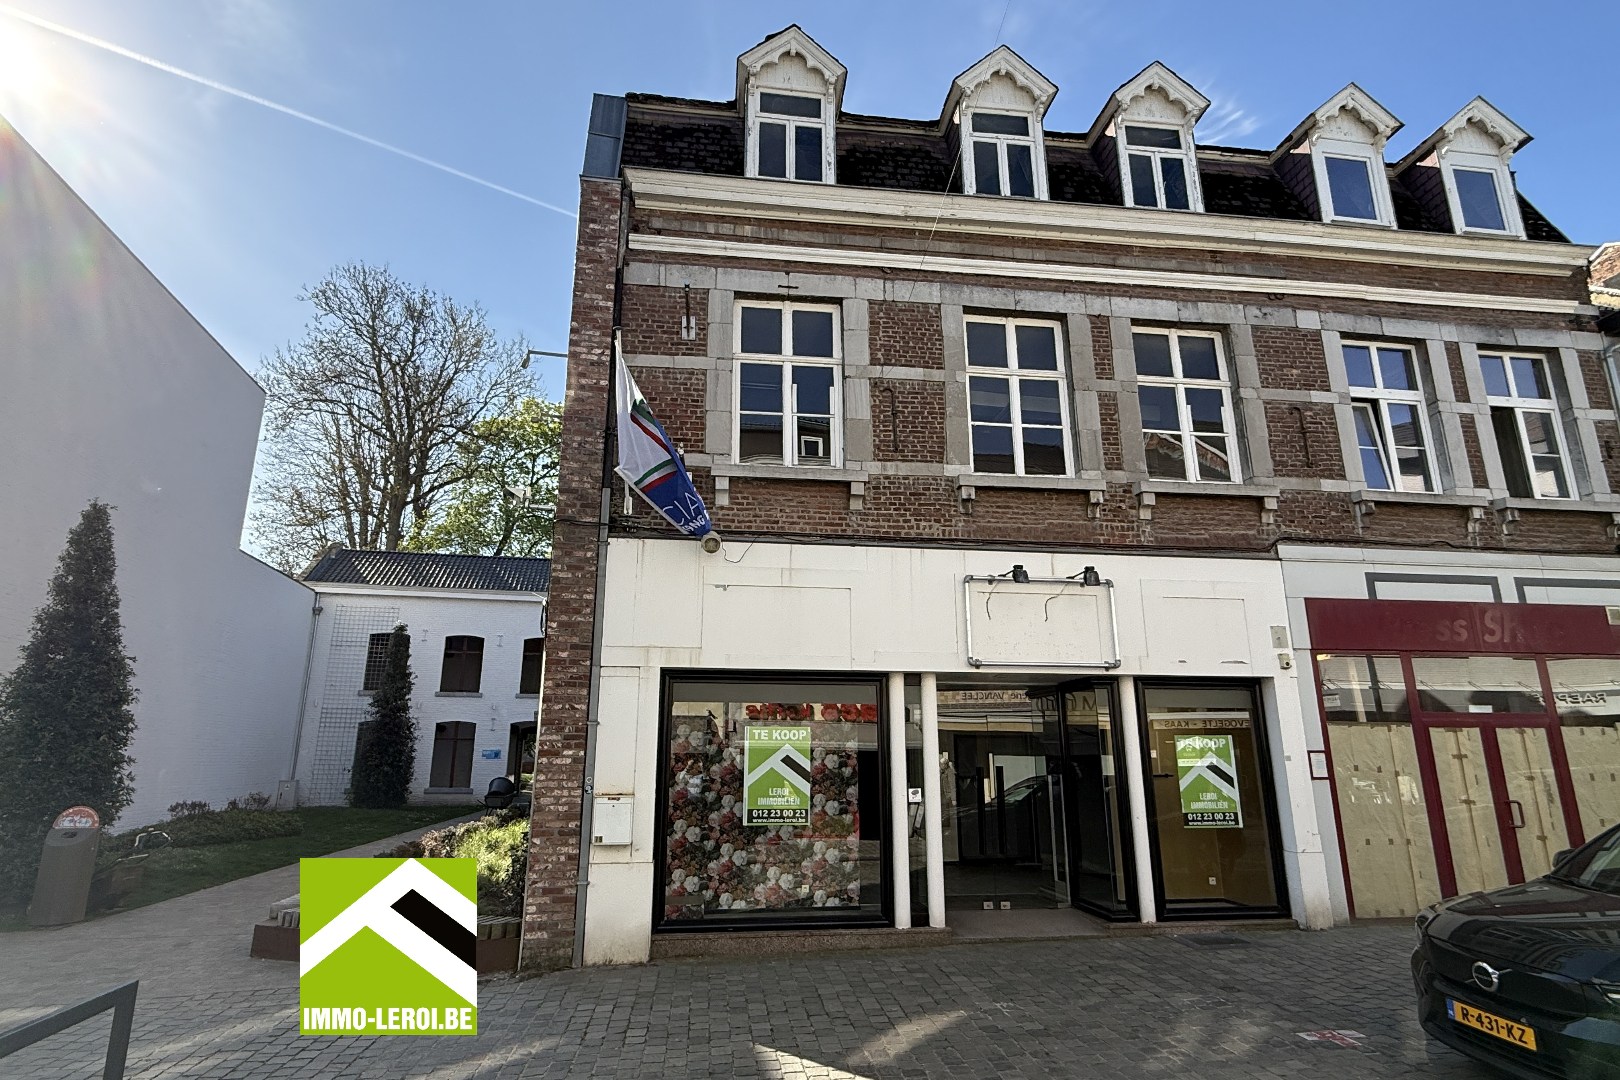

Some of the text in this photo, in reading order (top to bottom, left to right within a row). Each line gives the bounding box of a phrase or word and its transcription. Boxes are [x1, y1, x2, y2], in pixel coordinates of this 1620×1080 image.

[752, 729, 807, 740] TE KOOP
[1197, 738, 1226, 749] KOOP
[768, 787, 789, 796] LEROI
[752, 809, 806, 817] 012 23 00 23
[1187, 813, 1202, 821] 012
[1203, 813, 1213, 821] 23
[1214, 813, 1224, 821] 00
[1461, 1006, 1528, 1045] R-431-KZ
